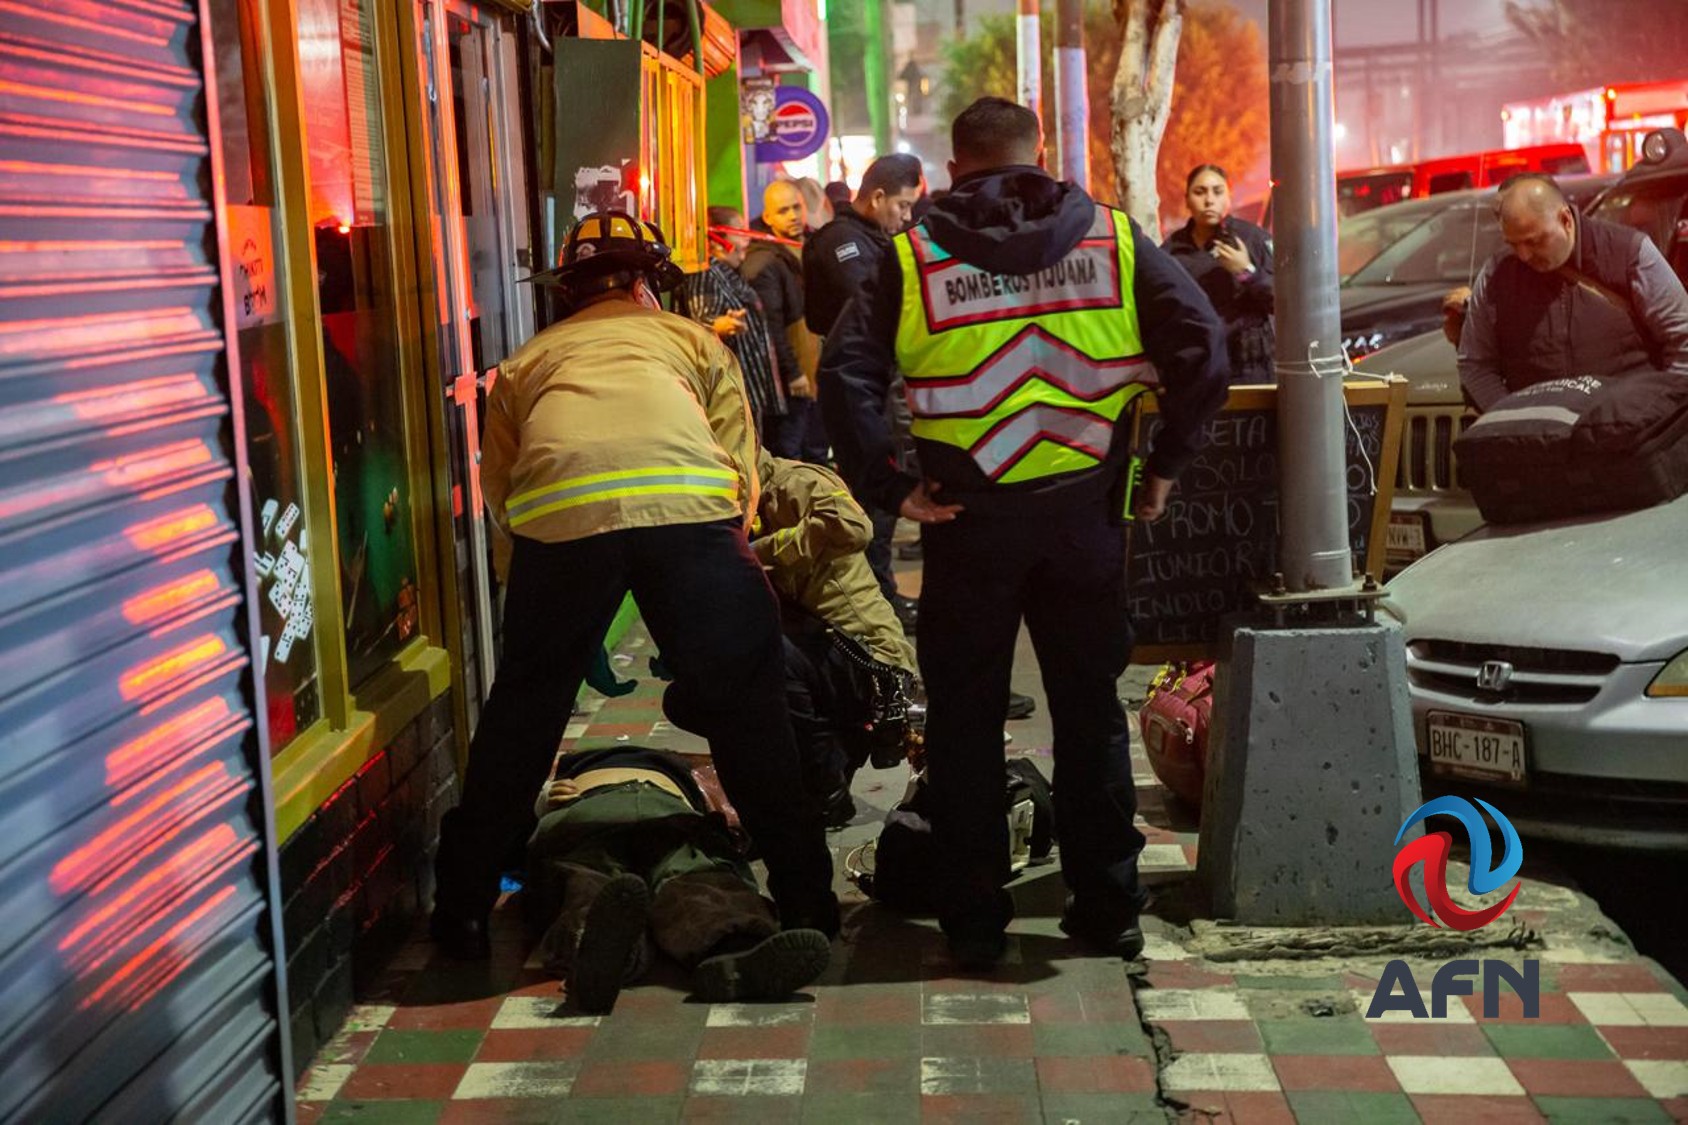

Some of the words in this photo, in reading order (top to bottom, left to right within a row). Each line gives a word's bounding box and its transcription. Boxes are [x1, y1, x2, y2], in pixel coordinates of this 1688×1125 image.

[777, 119, 813, 128] PEPSI
[945, 271, 1030, 306] BOMBEROS
[1132, 540, 1256, 585] JUNIOR
[1431, 729, 1521, 770] BHC-187-A
